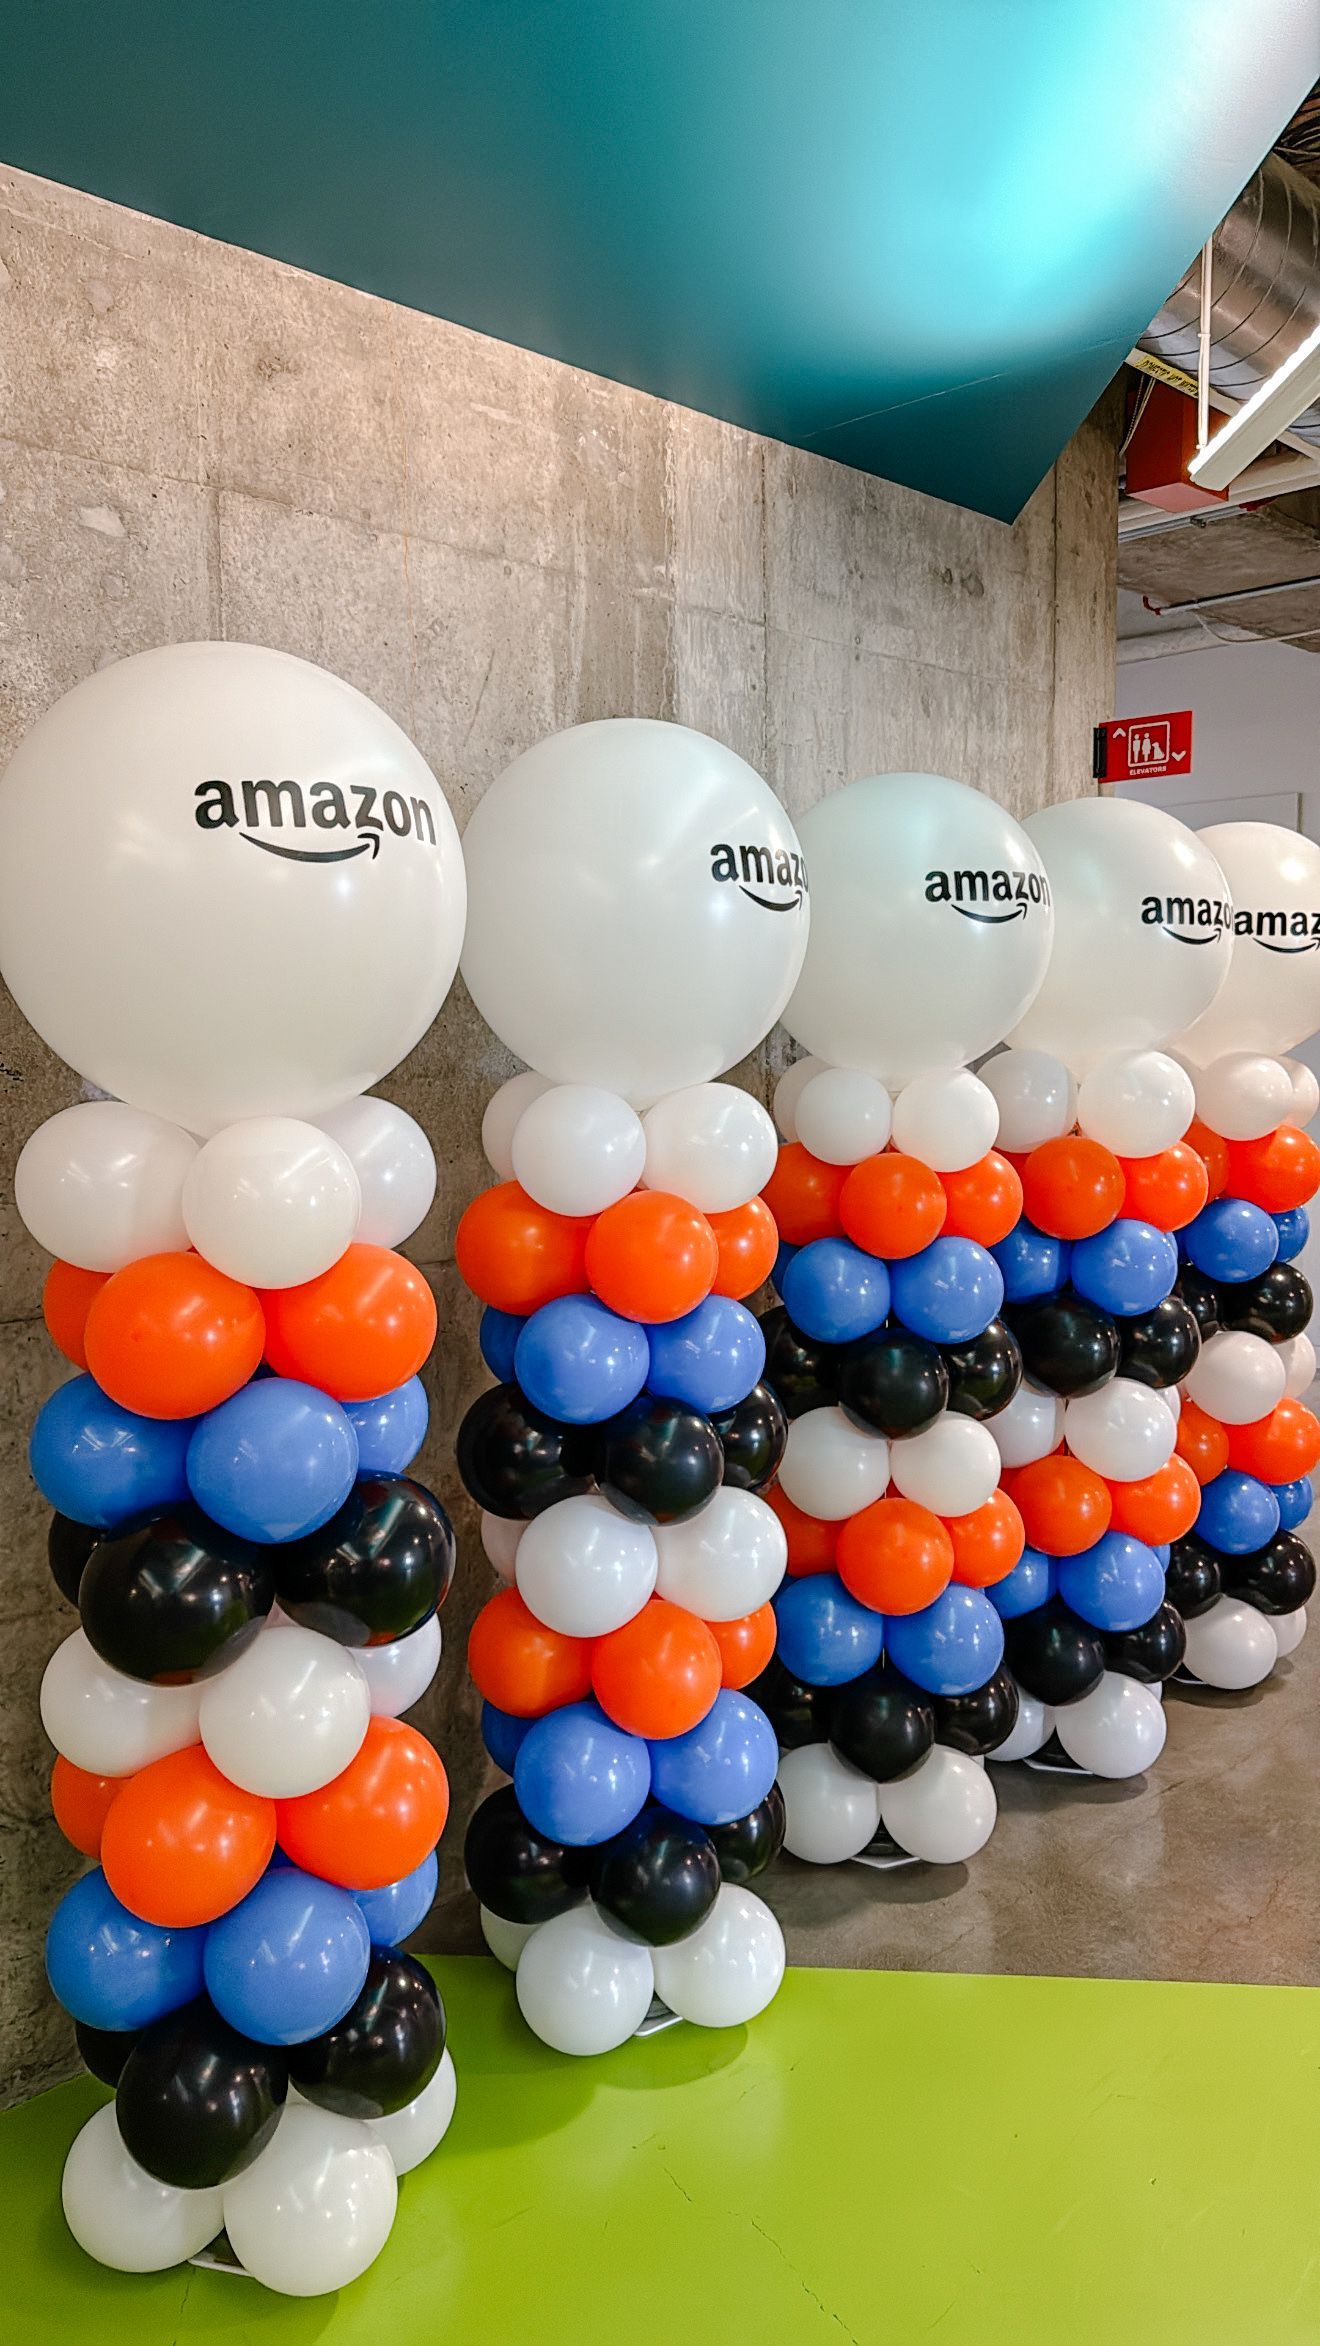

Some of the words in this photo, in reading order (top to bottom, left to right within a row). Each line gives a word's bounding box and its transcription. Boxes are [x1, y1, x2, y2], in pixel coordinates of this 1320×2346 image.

[1129, 765, 1167, 776] ELEVATORS
[194, 780, 437, 846] amazon
[924, 870, 1051, 908] amazon
